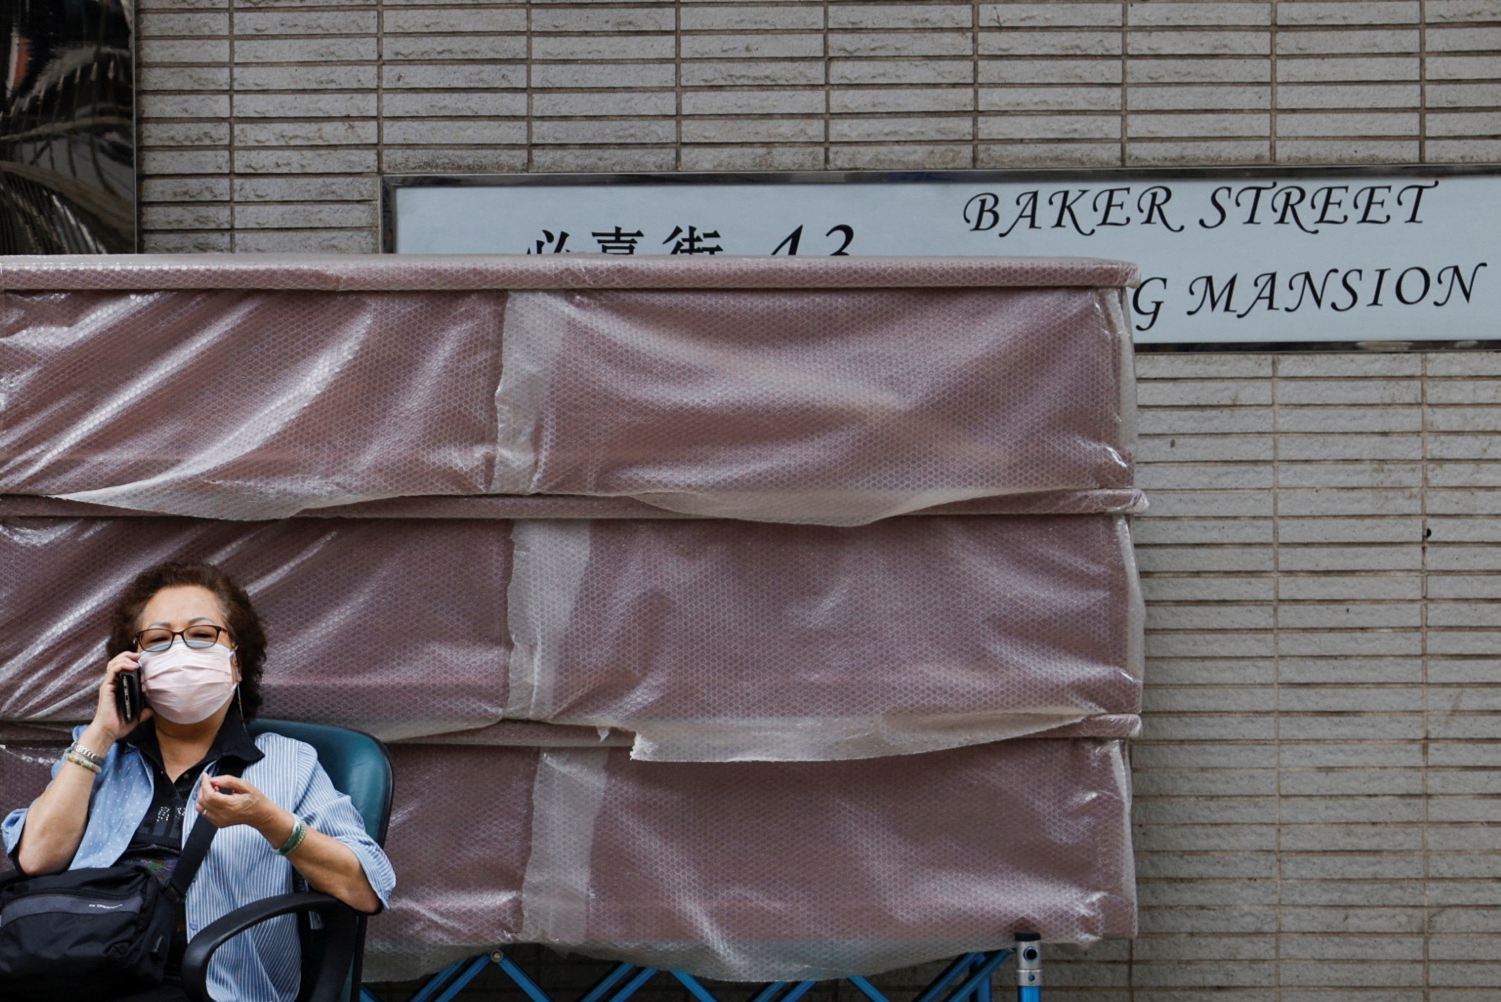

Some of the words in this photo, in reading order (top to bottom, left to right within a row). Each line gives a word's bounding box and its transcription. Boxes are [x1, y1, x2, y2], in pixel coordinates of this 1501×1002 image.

[964, 185, 1184, 237] BAKER
[1198, 180, 1439, 235] STREET
[1186, 262, 1488, 319] MANSION
